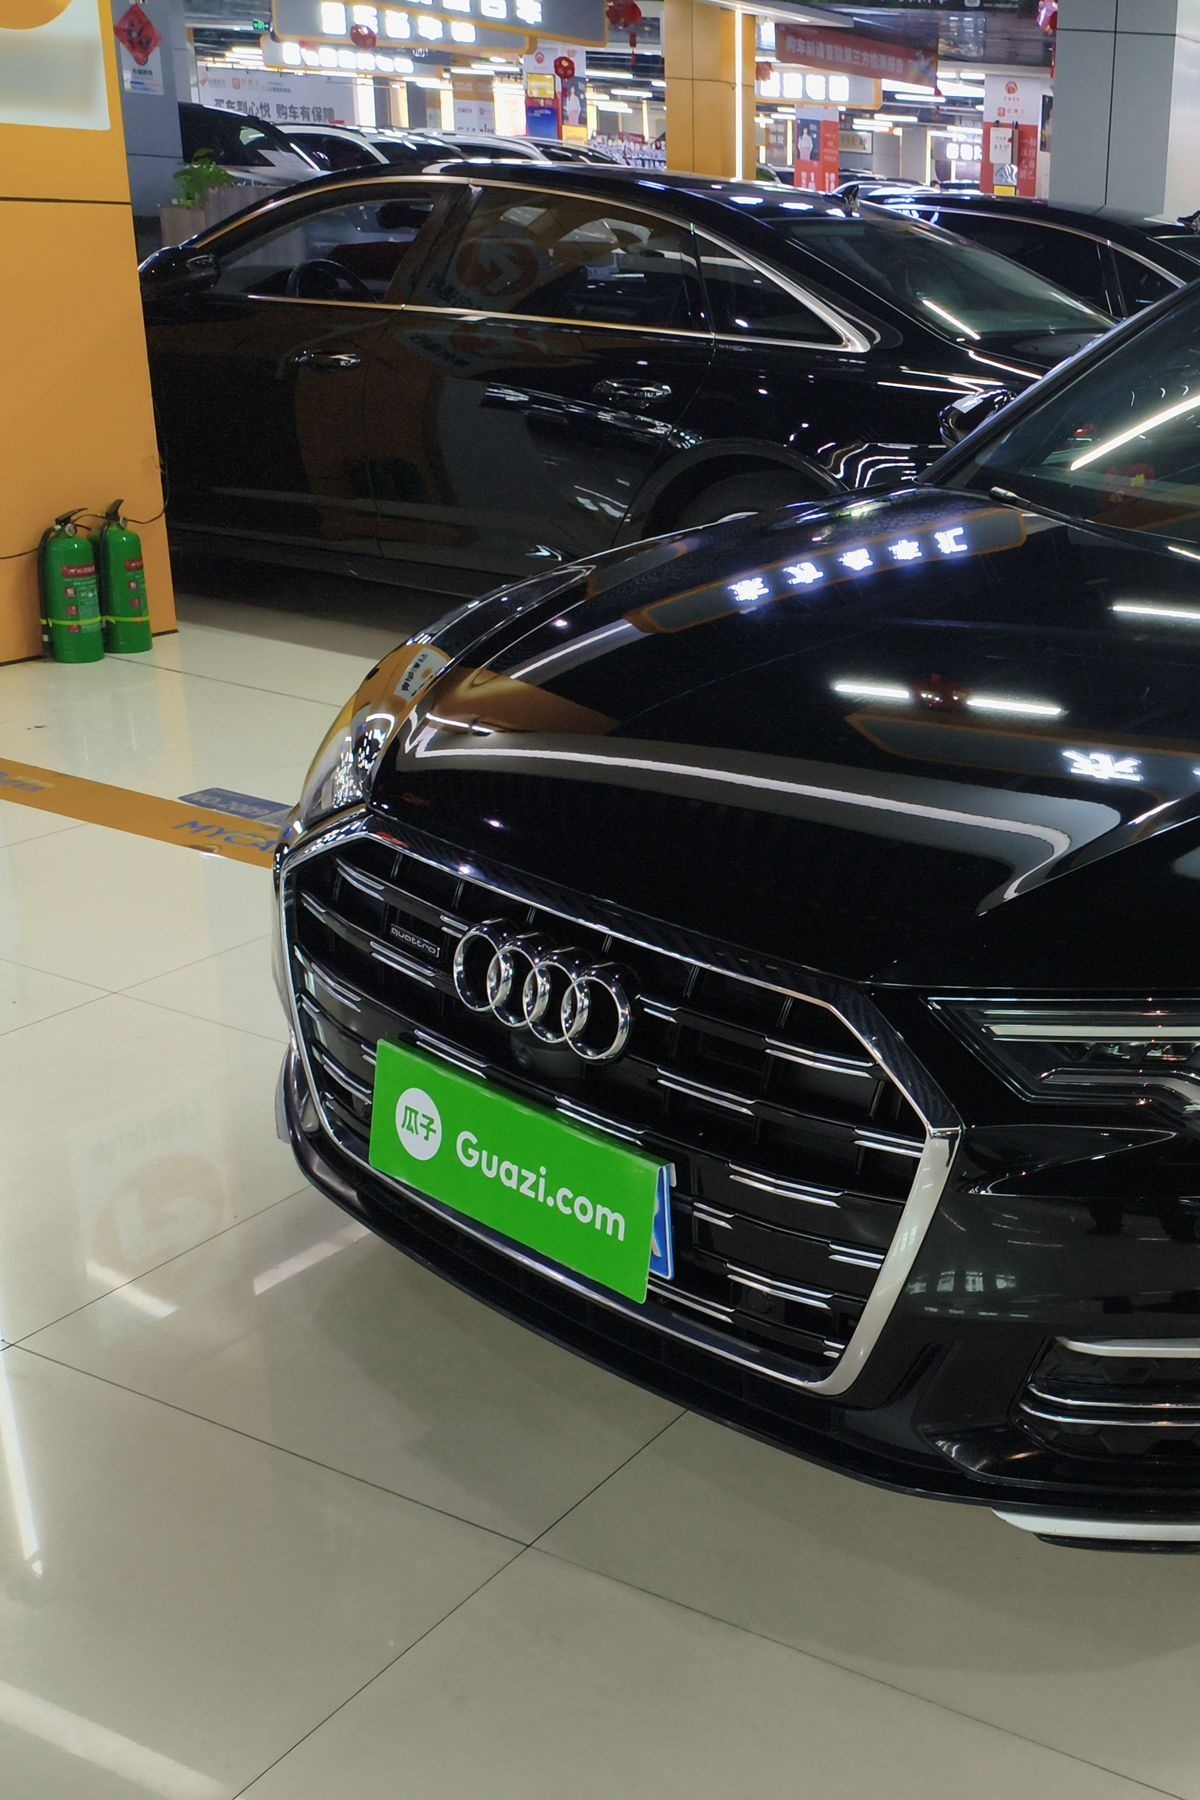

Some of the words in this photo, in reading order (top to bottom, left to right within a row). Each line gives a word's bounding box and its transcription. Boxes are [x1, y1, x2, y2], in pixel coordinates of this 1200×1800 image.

[391, 927, 436, 954] quattro
[401, 1105, 437, 1141] 瓜子
[456, 1130, 626, 1242] Guazi.com
